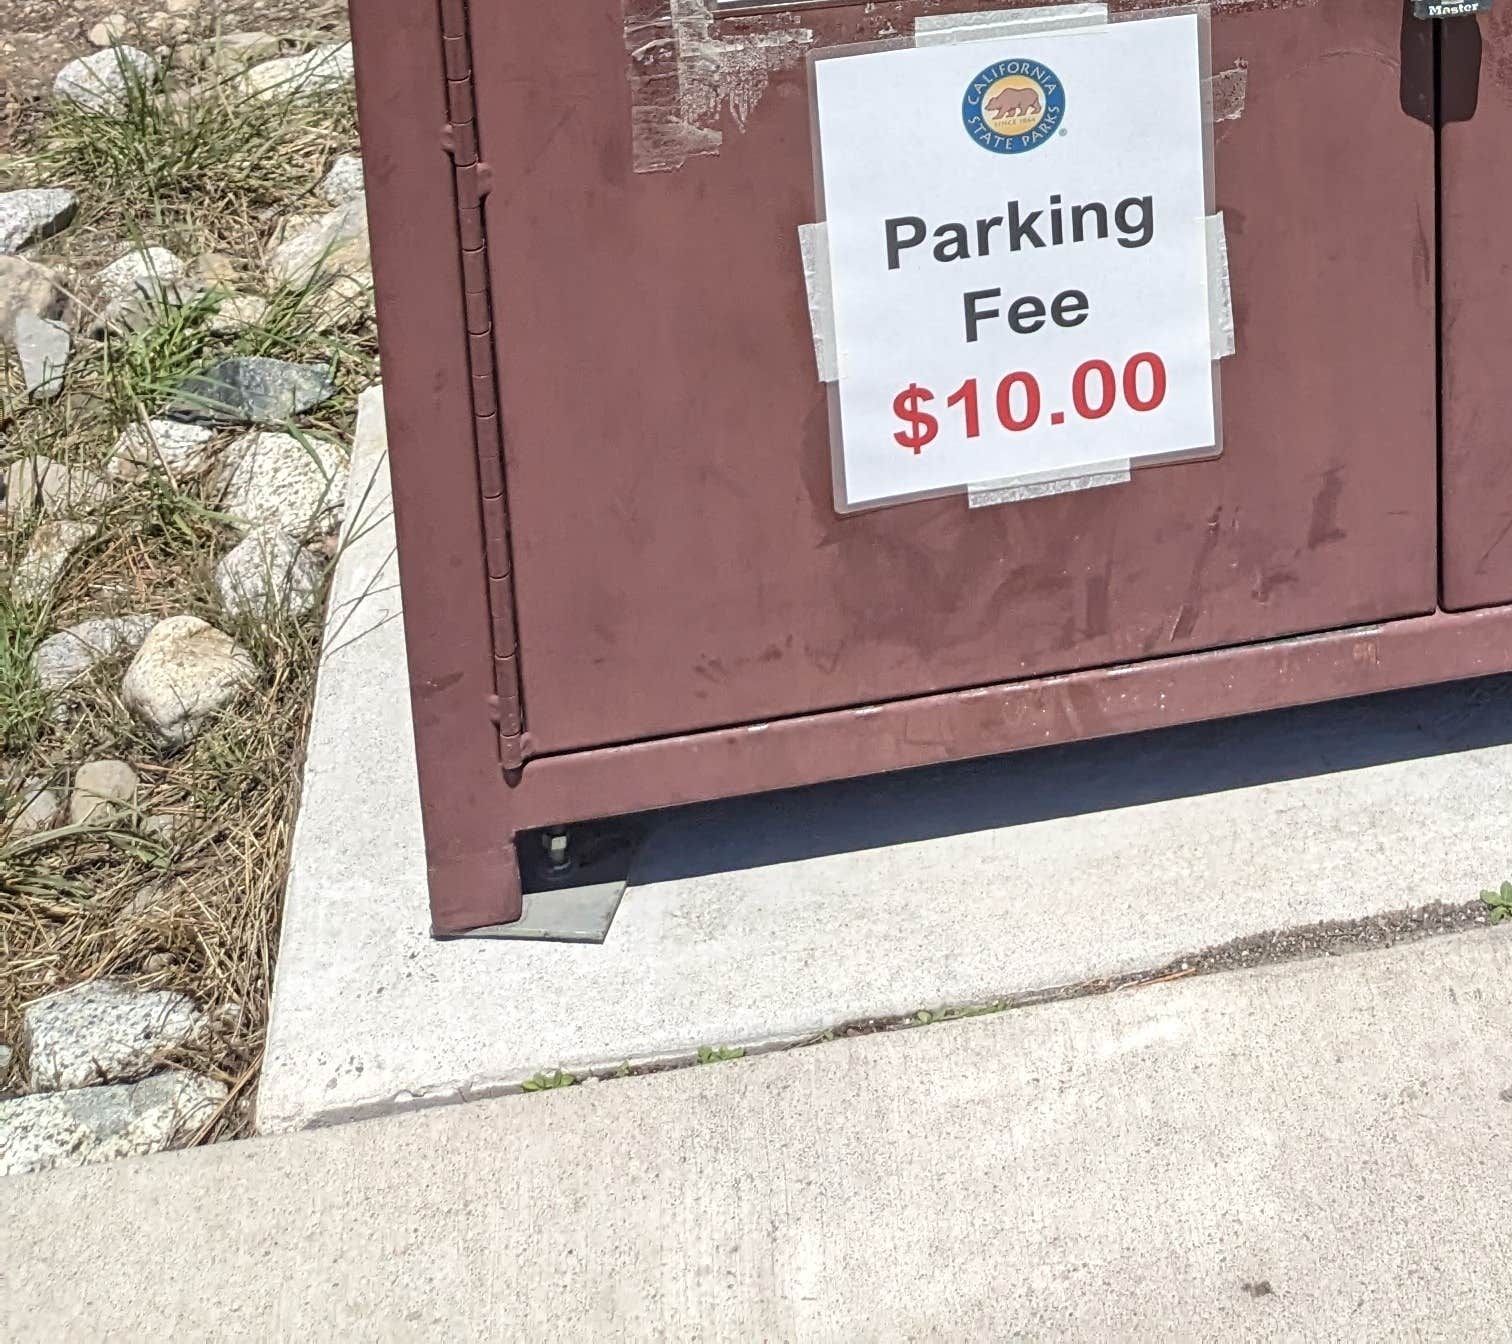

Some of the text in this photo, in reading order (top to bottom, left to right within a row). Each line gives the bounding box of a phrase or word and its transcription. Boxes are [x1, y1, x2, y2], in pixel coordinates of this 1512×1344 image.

[1428, 3, 1479, 16] Master
[968, 62, 1056, 105] CALIFORNIA
[968, 106, 1060, 150] STATE PARKS
[885, 194, 1154, 270] Parking
[963, 287, 1090, 343] Fee
[893, 352, 1166, 454] $10.00
